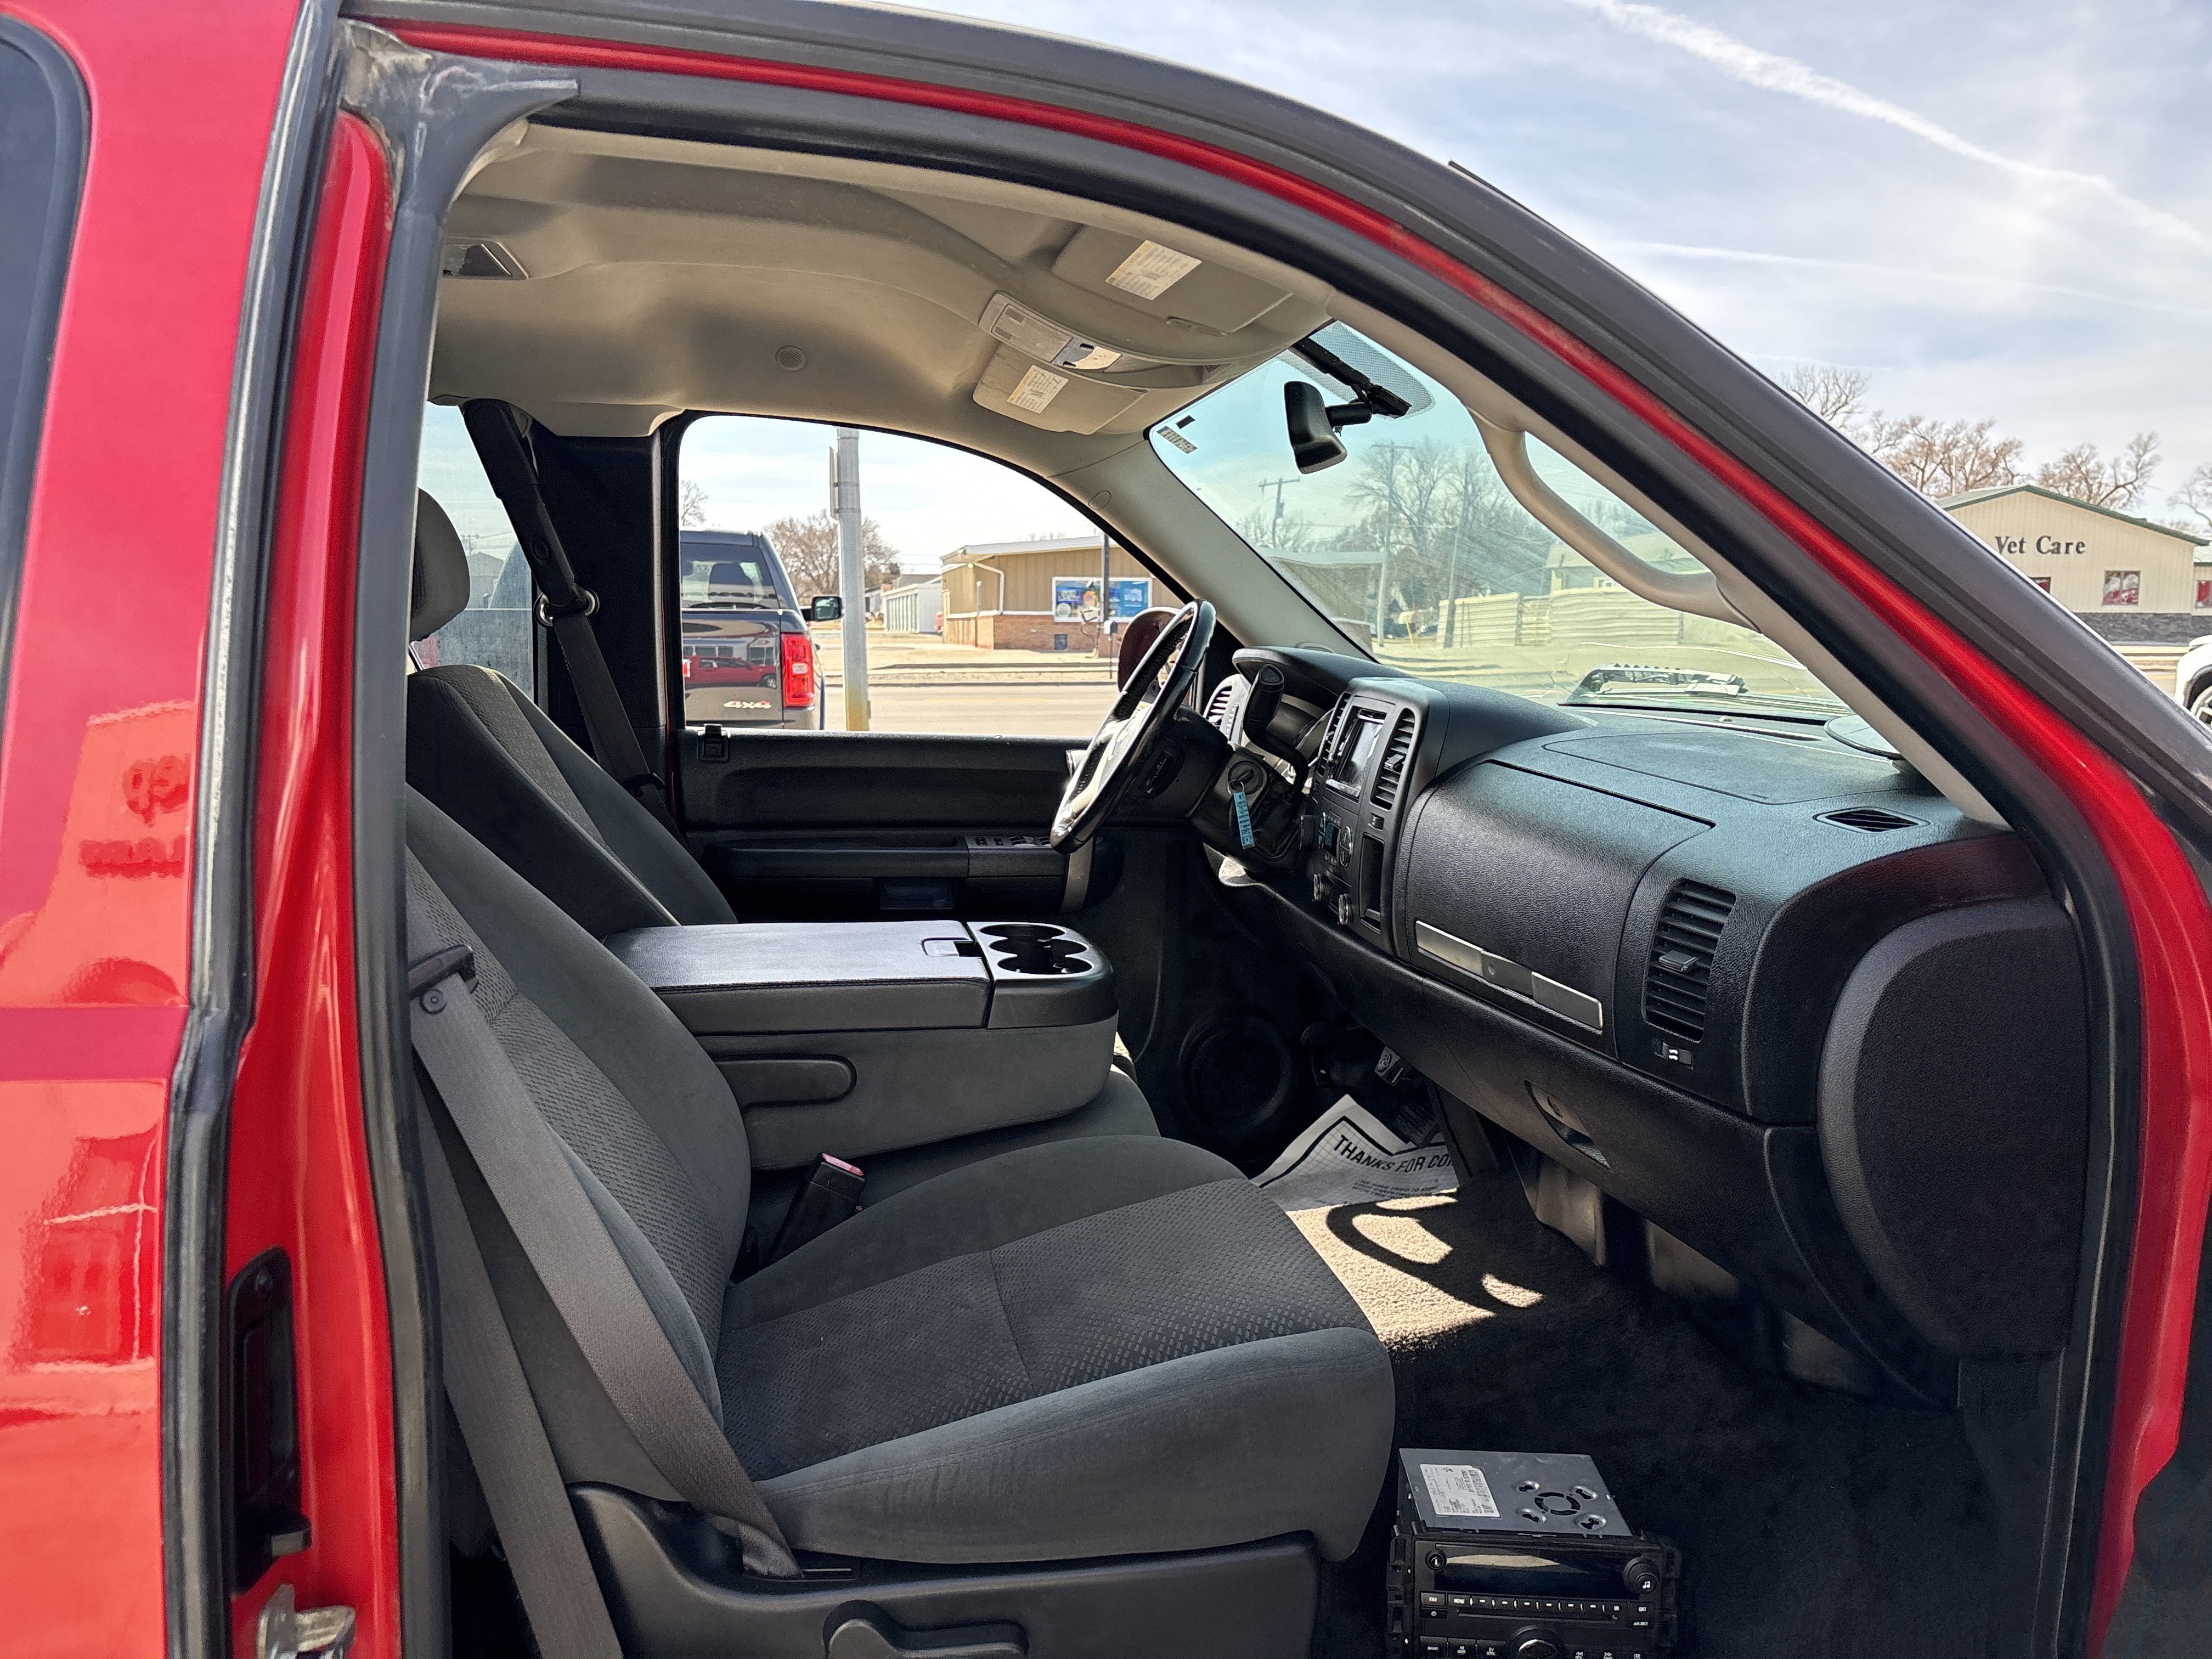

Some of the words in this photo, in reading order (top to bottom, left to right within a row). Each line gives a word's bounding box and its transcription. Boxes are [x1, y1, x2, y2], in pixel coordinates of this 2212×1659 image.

[1995, 535, 2026, 555] Vet
[2036, 535, 2086, 555] Care
[1334, 1134, 1395, 1171] THANKS
[1395, 1156, 1426, 1172] FOR
